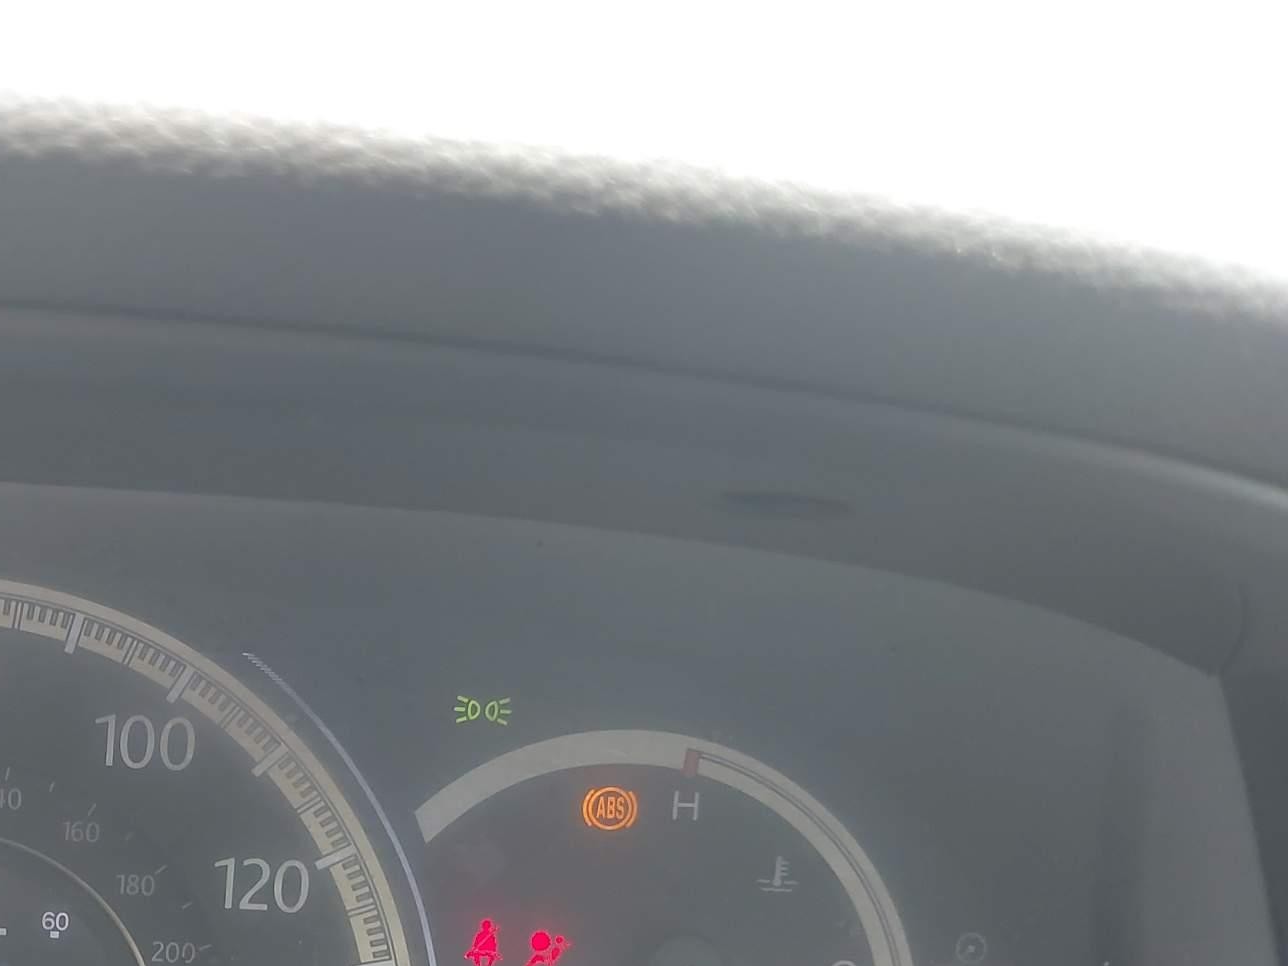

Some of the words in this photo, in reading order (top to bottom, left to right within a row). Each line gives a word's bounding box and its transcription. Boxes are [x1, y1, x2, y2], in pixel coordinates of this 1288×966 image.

[95, 714, 196, 771] 100
[595, 795, 626, 820] ABS
[672, 790, 700, 821] H
[63, 821, 100, 843] 160
[116, 874, 155, 897] 180
[214, 857, 310, 914] 120
[41, 911, 69, 931] 60
[151, 941, 196, 964] 200
